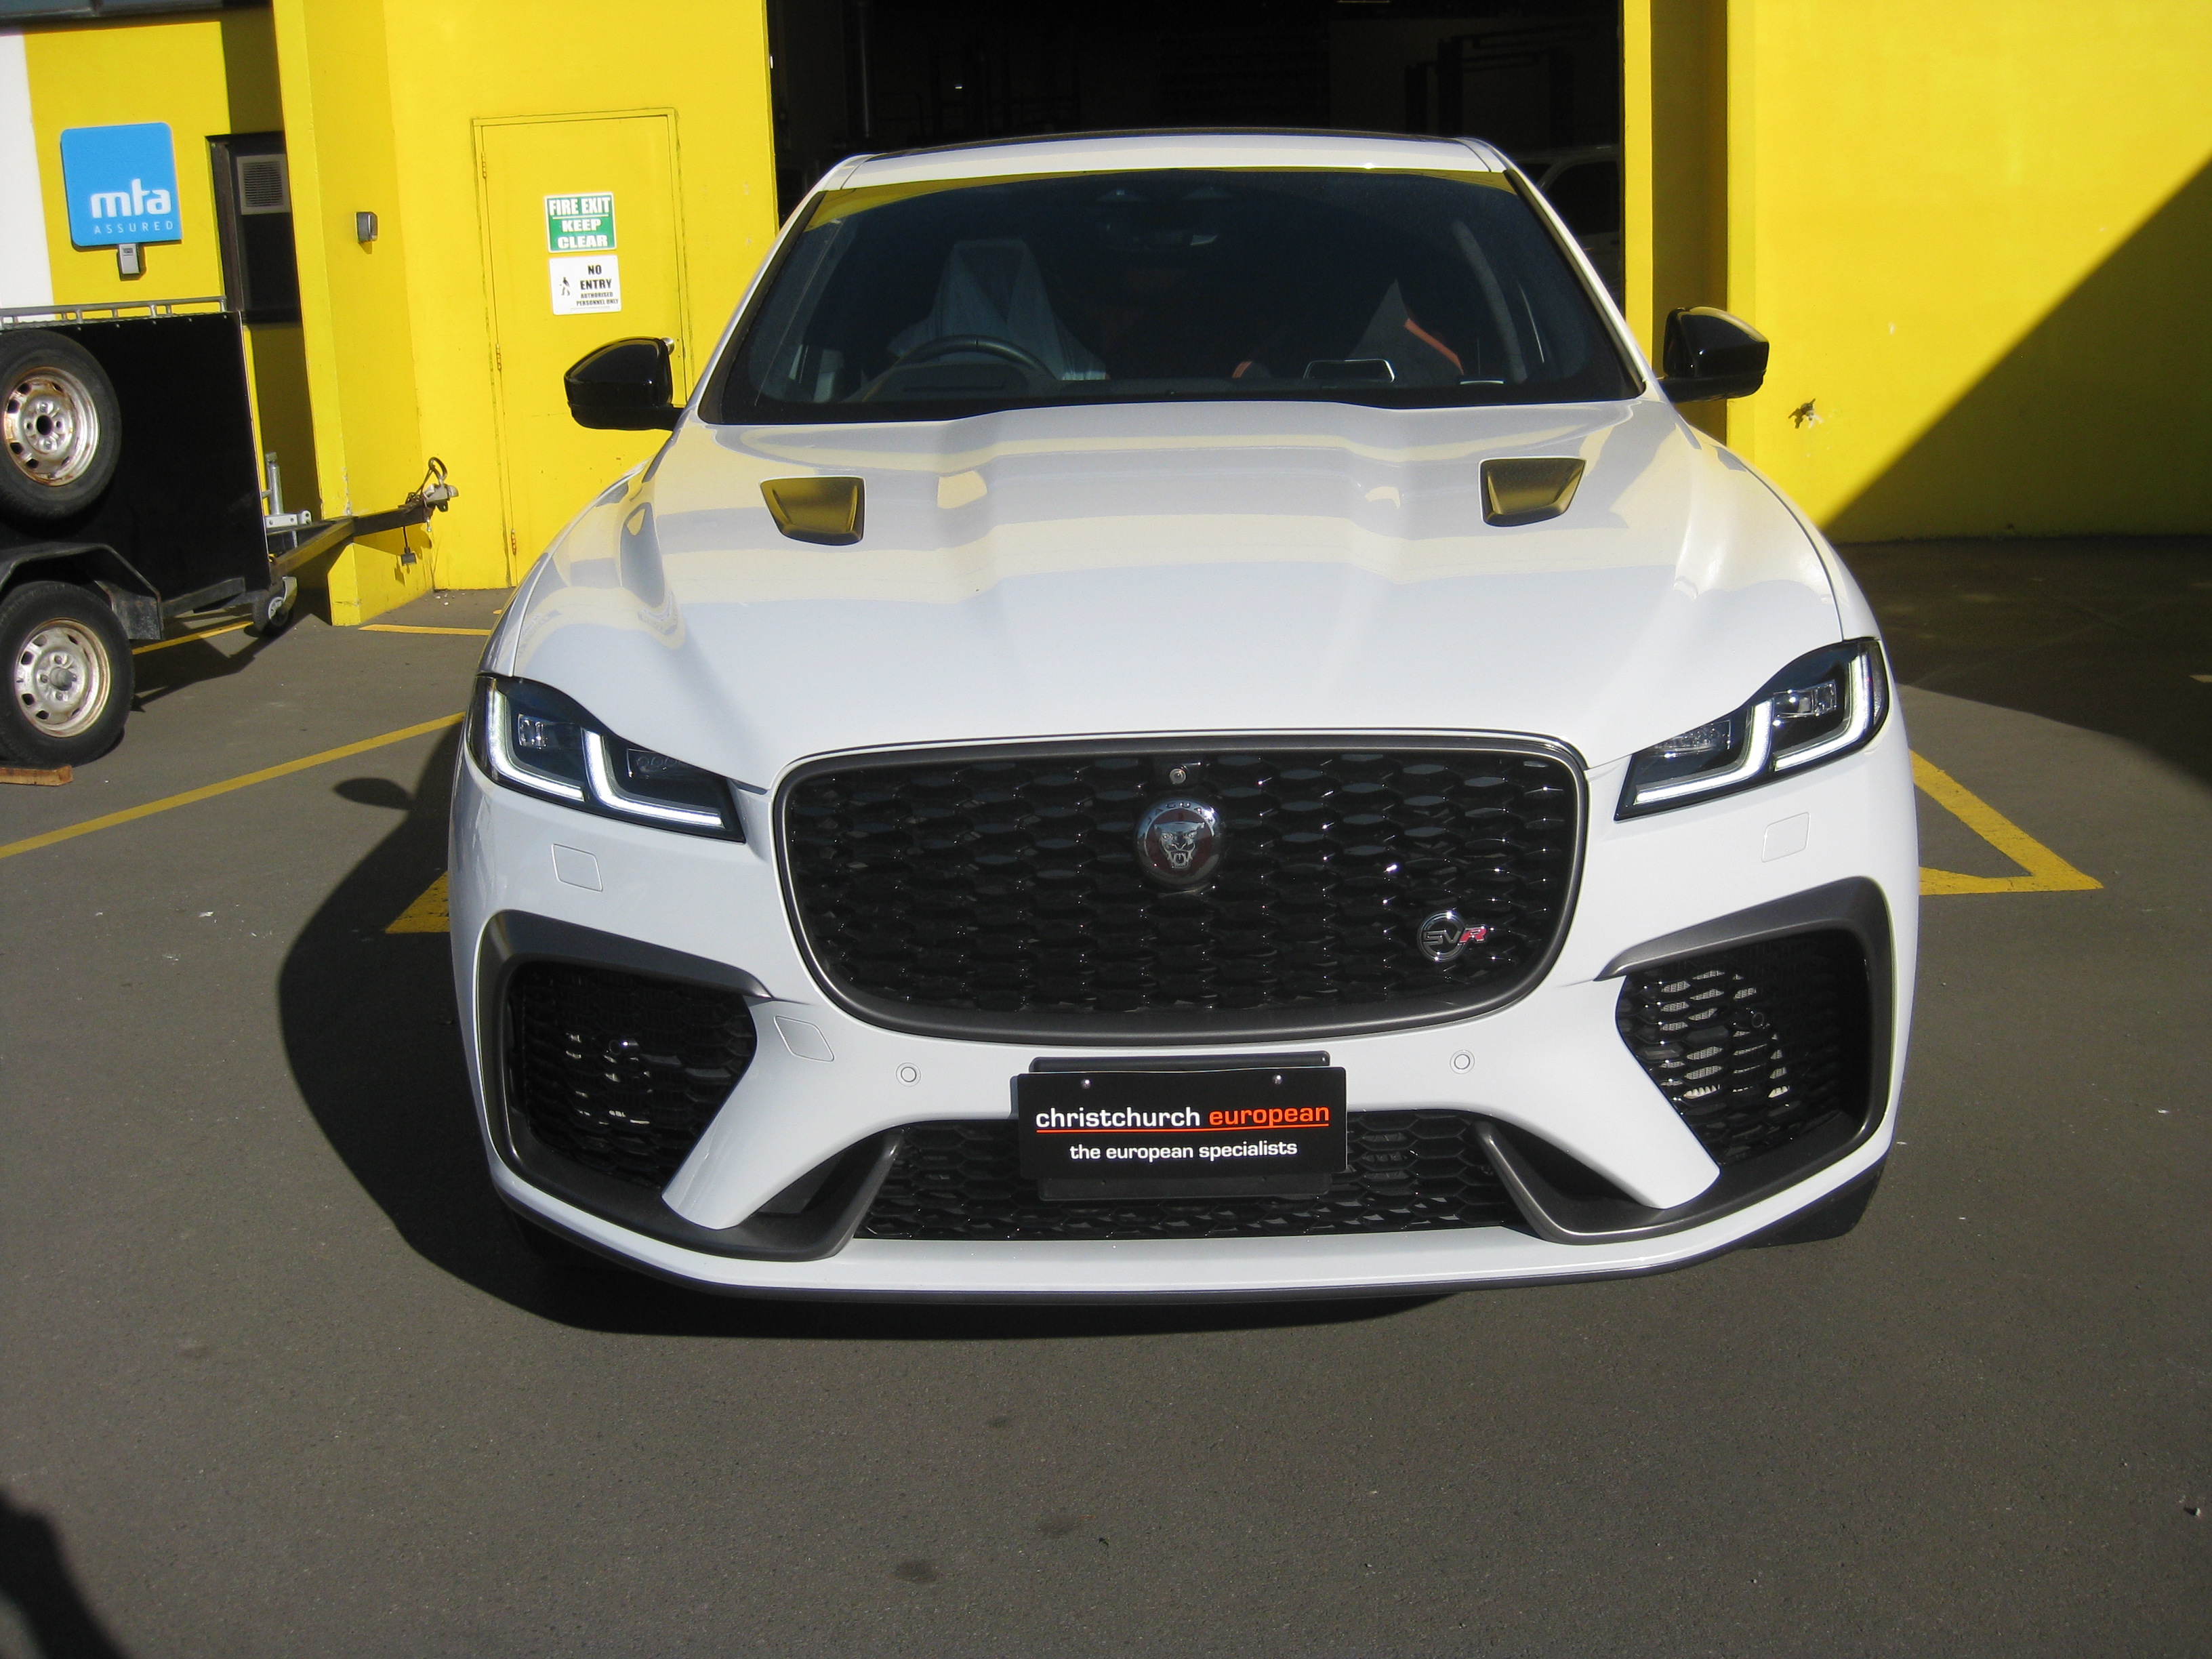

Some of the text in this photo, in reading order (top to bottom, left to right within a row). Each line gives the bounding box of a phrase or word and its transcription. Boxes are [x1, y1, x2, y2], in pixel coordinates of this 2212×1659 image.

[91, 178, 171, 218] mta
[548, 197, 611, 216] FIRE EXIT
[94, 220, 173, 234] ASSURED
[561, 218, 601, 232] KEEP
[557, 234, 609, 249] CLEAR
[588, 264, 602, 275] NO
[580, 279, 612, 290] ENTRY
[1036, 1105, 1330, 1129] christchurch european
[1069, 1140, 1298, 1163] the european specialists
